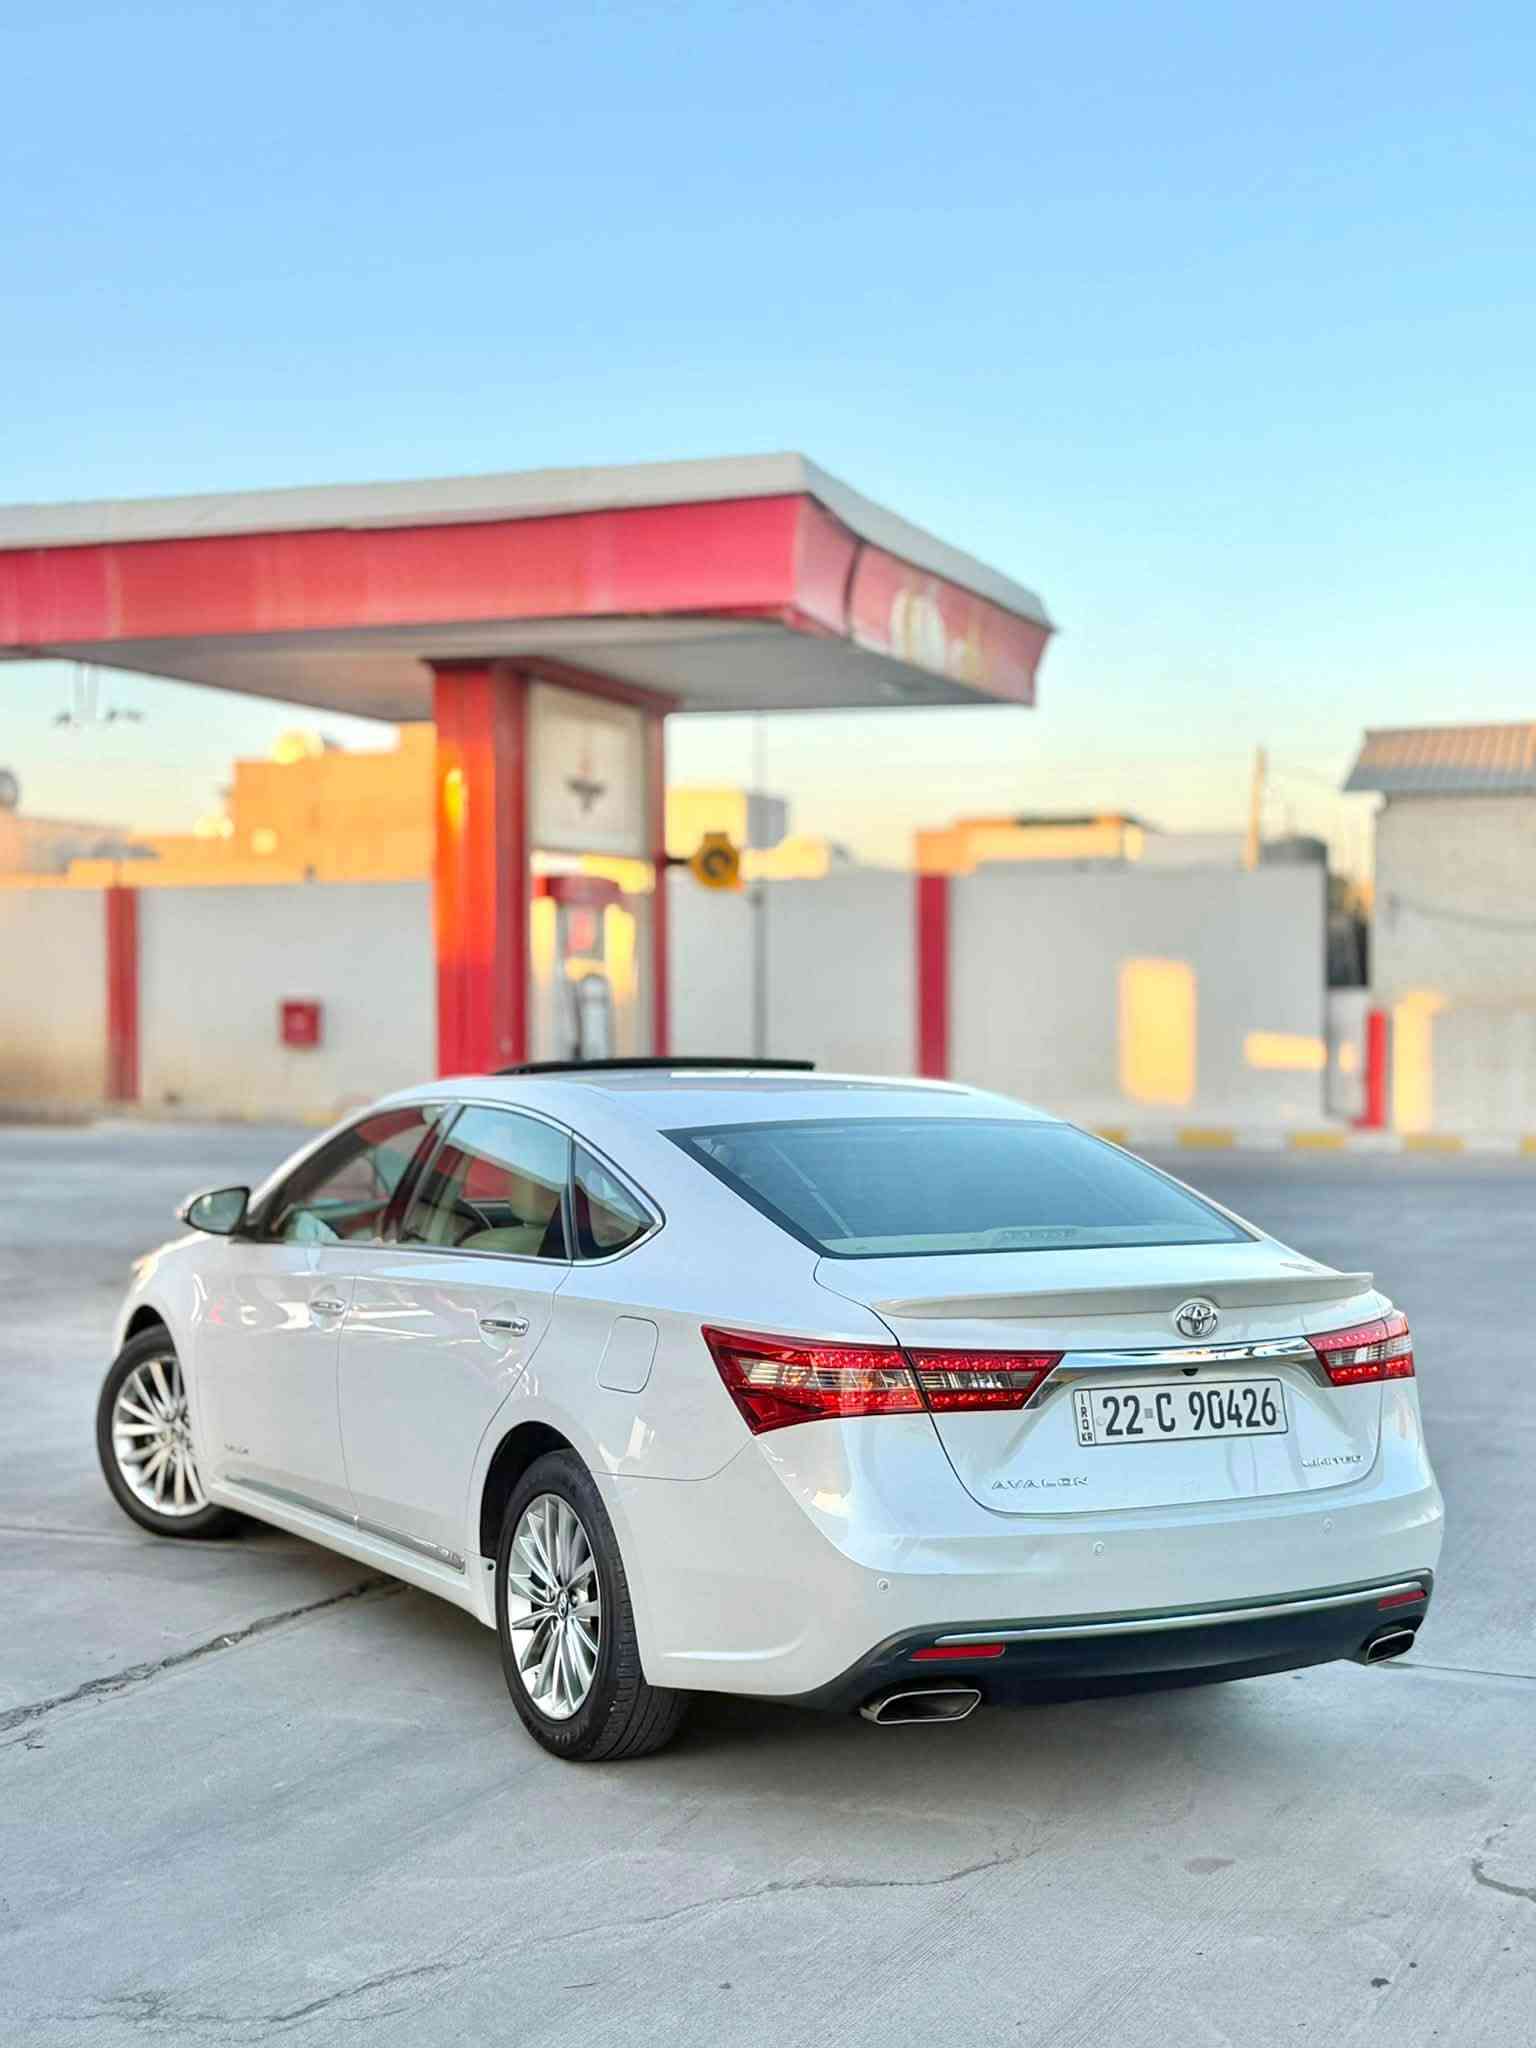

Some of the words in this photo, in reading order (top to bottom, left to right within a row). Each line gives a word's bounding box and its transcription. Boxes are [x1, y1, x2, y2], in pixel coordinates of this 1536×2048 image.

[1102, 1394, 1144, 1436] 22
[1155, 1392, 1176, 1432] C
[1188, 1387, 1277, 1430] 90426
[1081, 1432, 1093, 1441] KR
[991, 1476, 1088, 1490] AVALON
